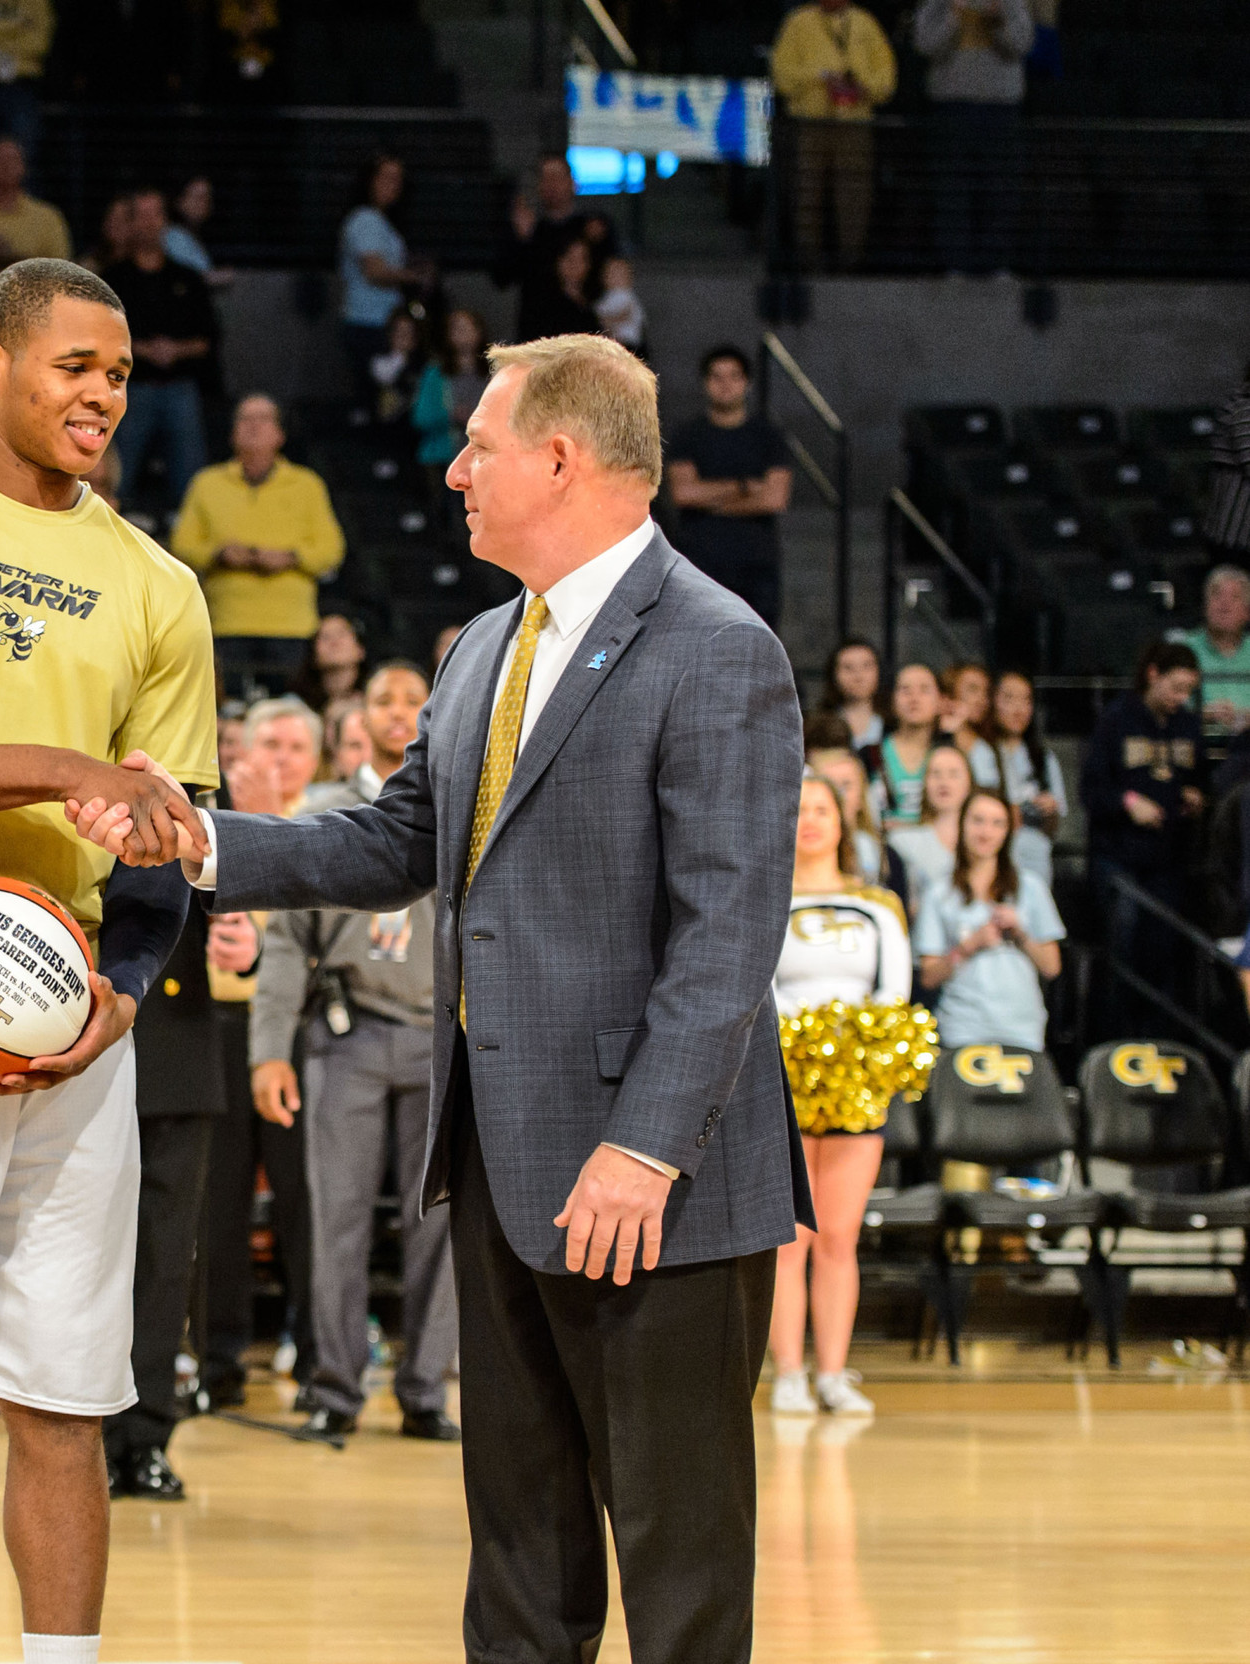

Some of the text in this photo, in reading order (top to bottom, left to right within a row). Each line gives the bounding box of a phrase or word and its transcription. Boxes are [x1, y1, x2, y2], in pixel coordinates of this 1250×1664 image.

[68, 583, 102, 601] WE
[11, 922, 86, 1002] GEORGES-HUNT
[2, 985, 12, 997] 31,
[11, 991, 26, 1007] 2015
[9, 975, 18, 986] vs.
[18, 981, 32, 997] N.C.
[30, 991, 51, 1013] STATE
[35, 967, 70, 1005] POINTS
[953, 1042, 1034, 1094] GT
[1109, 1042, 1188, 1094] GT
